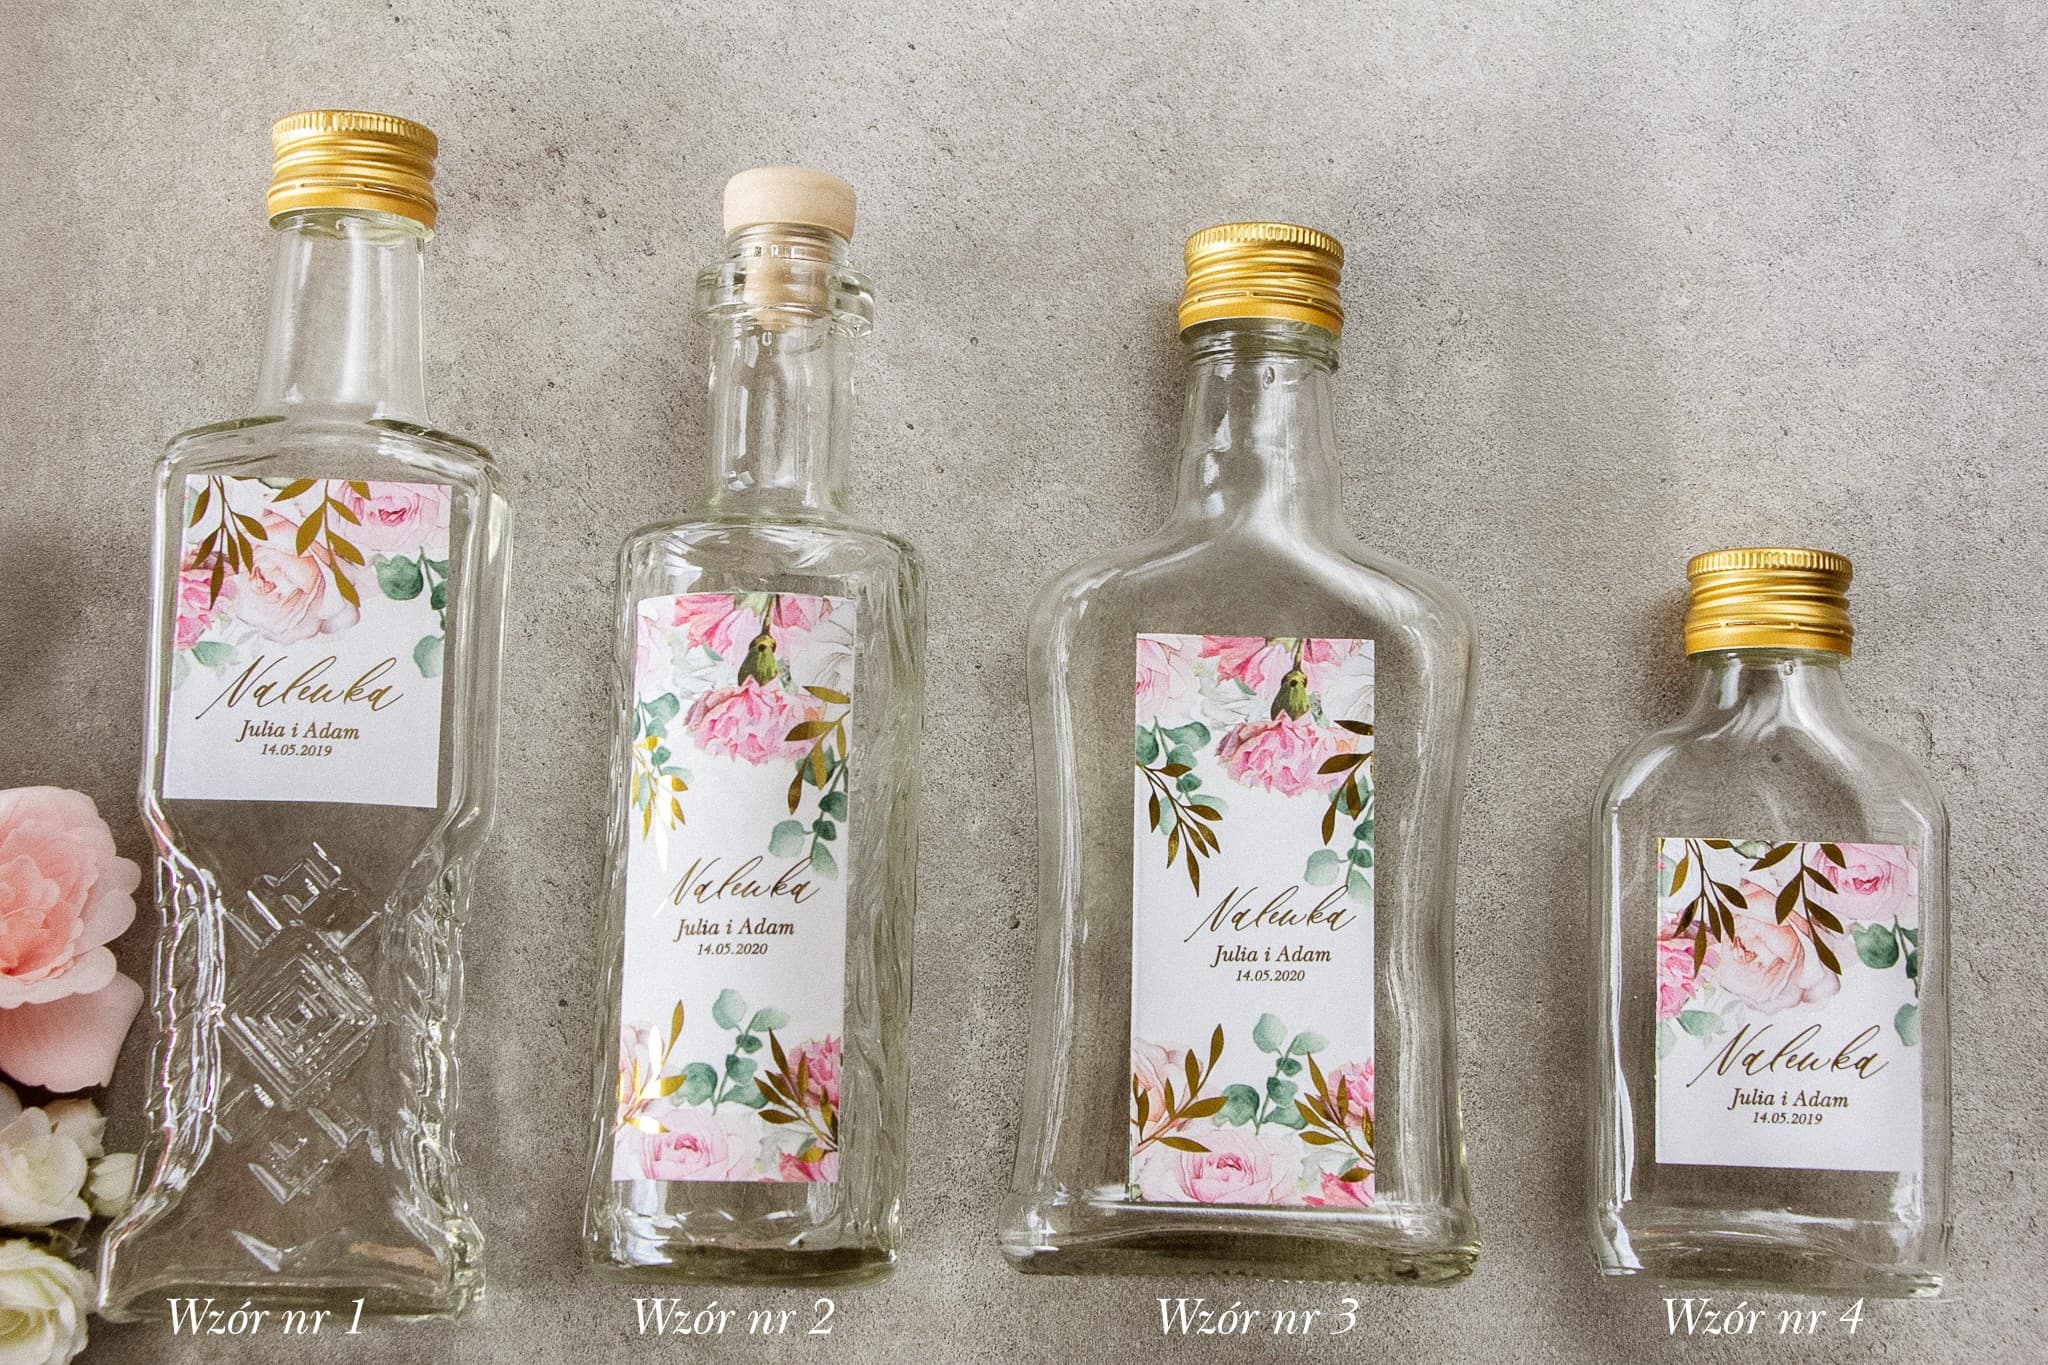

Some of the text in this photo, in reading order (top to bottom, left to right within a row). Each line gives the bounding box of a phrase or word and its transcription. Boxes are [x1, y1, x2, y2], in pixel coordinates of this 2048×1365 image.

[195, 655, 404, 721] Nalewka
[235, 719, 360, 742] Julia i Adam
[261, 743, 333, 757] 14.05.2019
[655, 855, 820, 916] Nalewka
[1183, 884, 1357, 943] Nalewka
[673, 917, 795, 943] Julia i Adam
[698, 942, 769, 956] 14.05.2020
[1209, 944, 1332, 969] Julia i Adam
[1236, 969, 1306, 983] 14.05.2020
[1686, 1023, 1890, 1089] Nalewka
[1727, 1087, 1849, 1111] Julia i Adam
[1752, 1111, 1823, 1126] 14.05.2019
